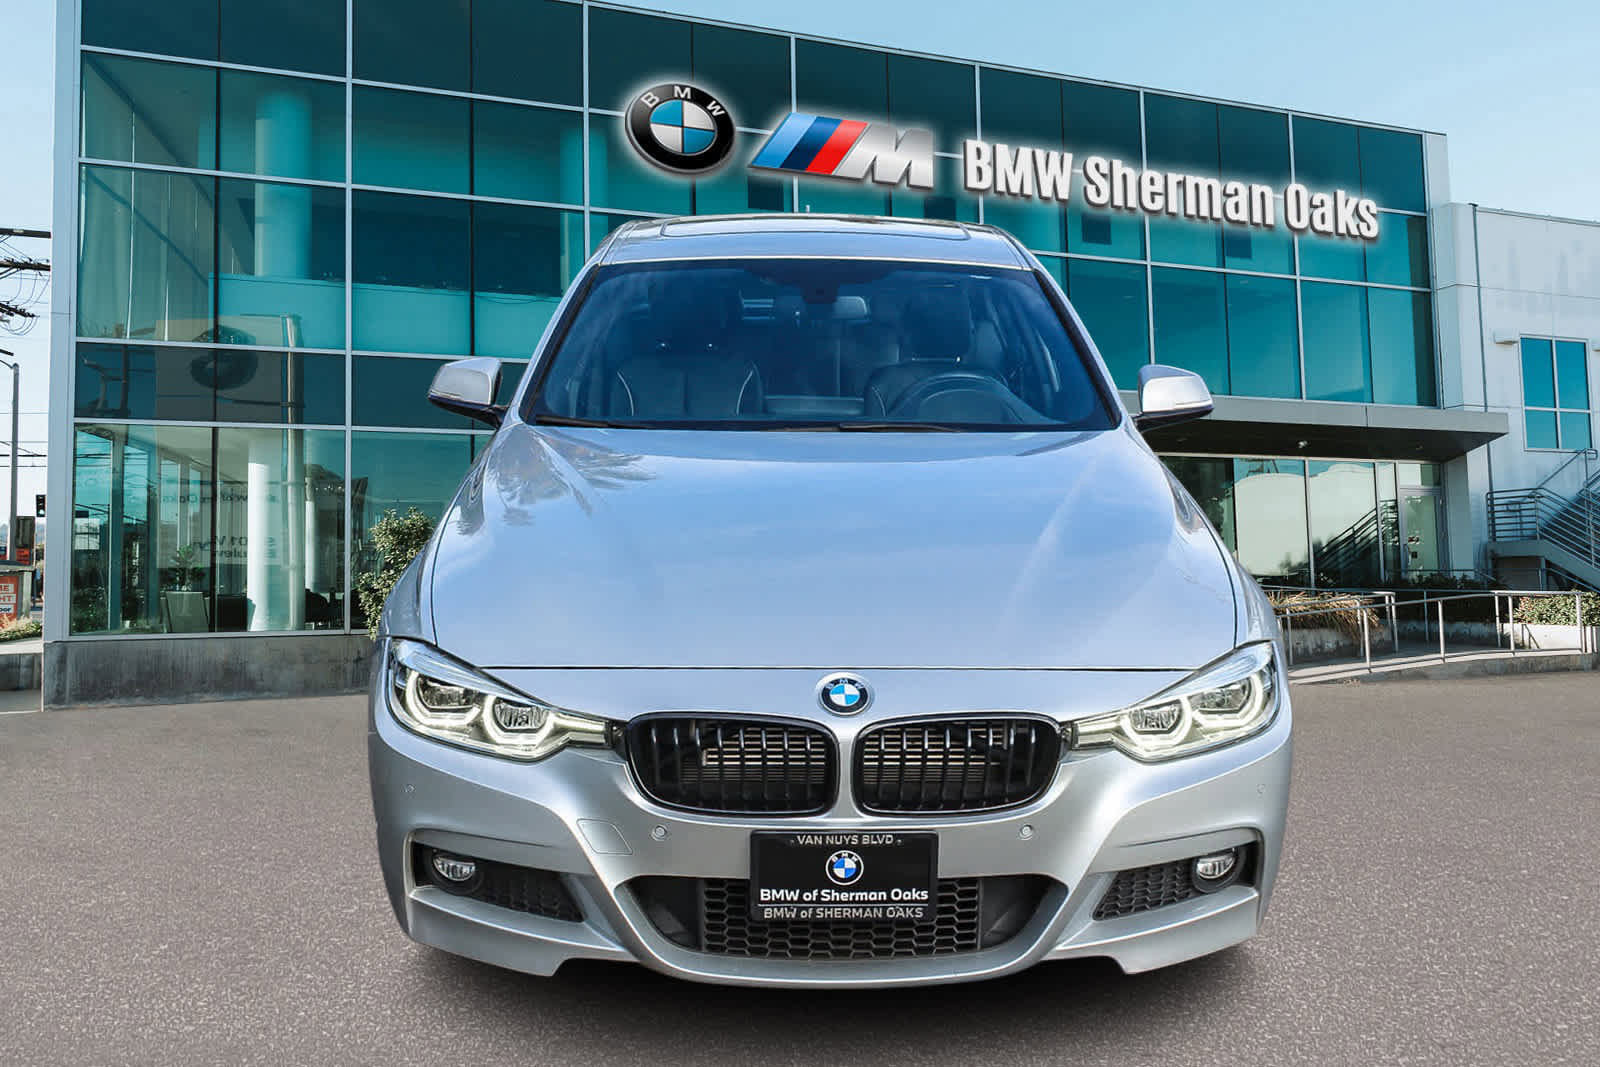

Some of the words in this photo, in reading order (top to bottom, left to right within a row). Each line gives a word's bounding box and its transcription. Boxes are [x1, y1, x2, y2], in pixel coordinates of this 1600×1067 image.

[641, 84, 725, 117] BMW
[963, 138, 1073, 202] BMW
[1082, 155, 1276, 227] Sherman
[1283, 182, 1380, 242] Oaks
[797, 835, 823, 845] VAN
[826, 835, 859, 845] NUYS
[862, 834, 894, 844] BLVD
[760, 889, 800, 901] BMW
[803, 889, 818, 901] of
[820, 889, 887, 901] Sherman
[891, 888, 929, 900] Oaks
[764, 907, 797, 919] BMW
[800, 907, 813, 918] of
[815, 907, 883, 918] SHERMAN
[886, 906, 924, 918] OAKS
